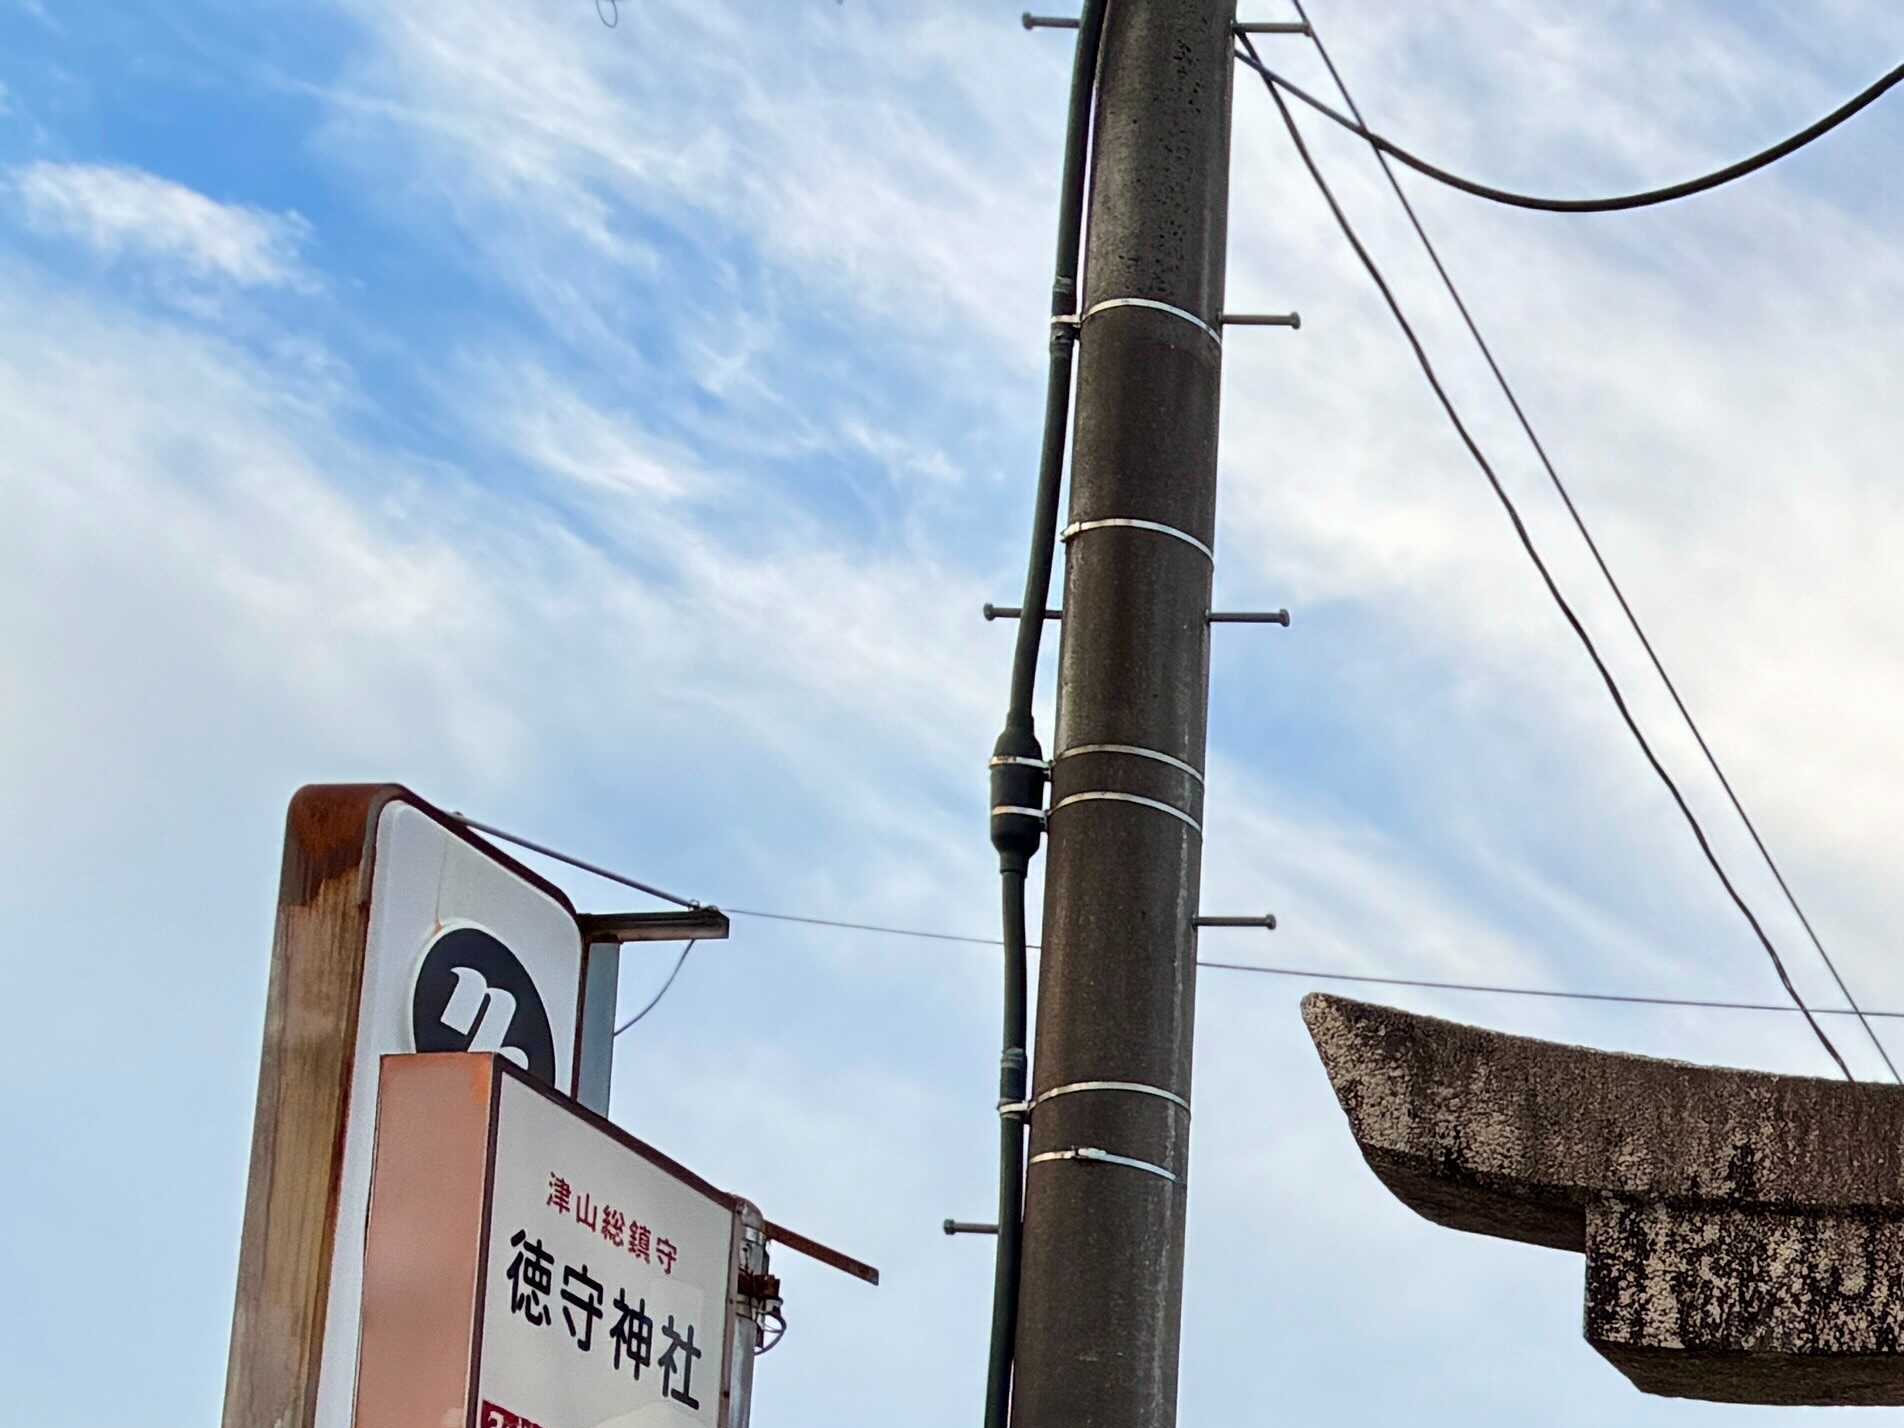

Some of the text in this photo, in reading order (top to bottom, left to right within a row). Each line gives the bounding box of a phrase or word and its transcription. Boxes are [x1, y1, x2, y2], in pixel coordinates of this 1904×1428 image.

[546, 1171, 678, 1275] 津山総鎮守
[506, 1229, 702, 1410] 徳守神社
